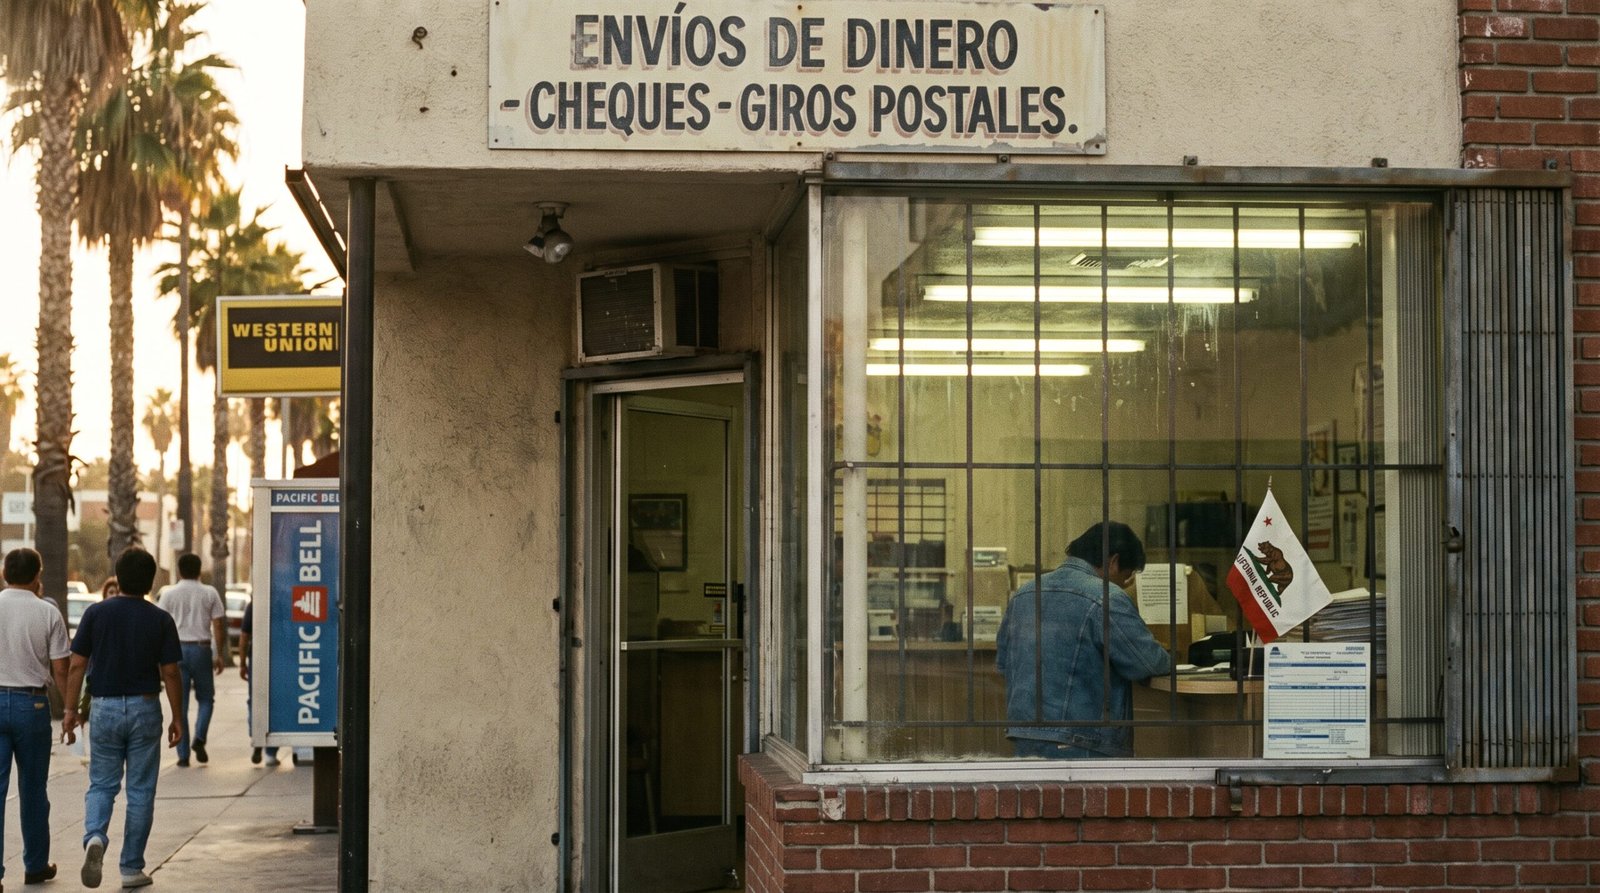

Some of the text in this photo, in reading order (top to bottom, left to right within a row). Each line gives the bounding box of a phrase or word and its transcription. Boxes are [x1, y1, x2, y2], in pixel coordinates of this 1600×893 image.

[573, 2, 1018, 72] ENVÍOS DE DINERO
[872, 84, 1078, 135] POSTALES.
[232, 322, 333, 338] WESTERN
[264, 337, 333, 353] UNION
[276, 492, 318, 504] PACIFIC
[1254, 584, 1280, 618] REPUBLIC
[298, 519, 322, 725] PACIFIC BELL
